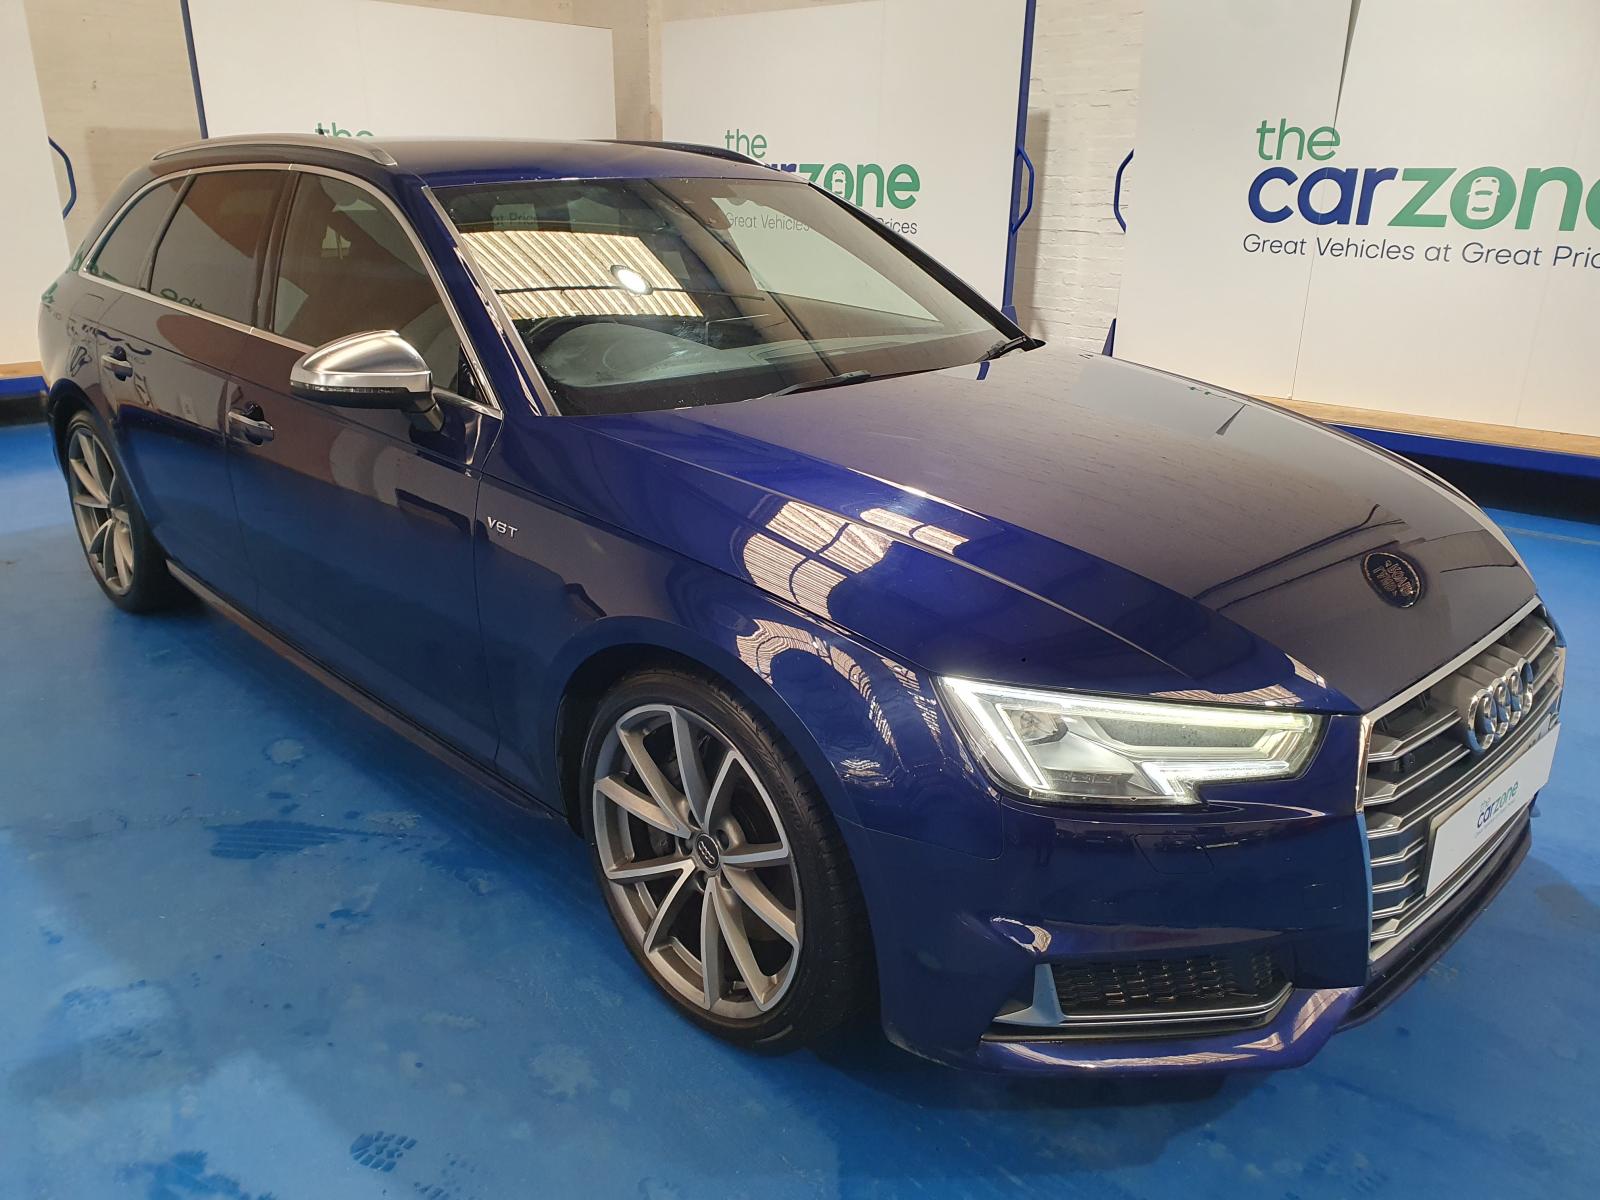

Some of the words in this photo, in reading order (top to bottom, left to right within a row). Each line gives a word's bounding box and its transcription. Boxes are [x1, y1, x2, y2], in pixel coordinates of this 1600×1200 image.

[725, 129, 767, 158] the
[1256, 118, 1341, 160] the
[1248, 166, 1600, 231] carzon
[726, 212, 757, 228] Great
[1243, 233, 1307, 256] Great
[1316, 237, 1415, 261] Vehicles
[1424, 244, 1452, 262] at
[1462, 242, 1542, 266] Great
[1477, 781, 1519, 828] carzone
